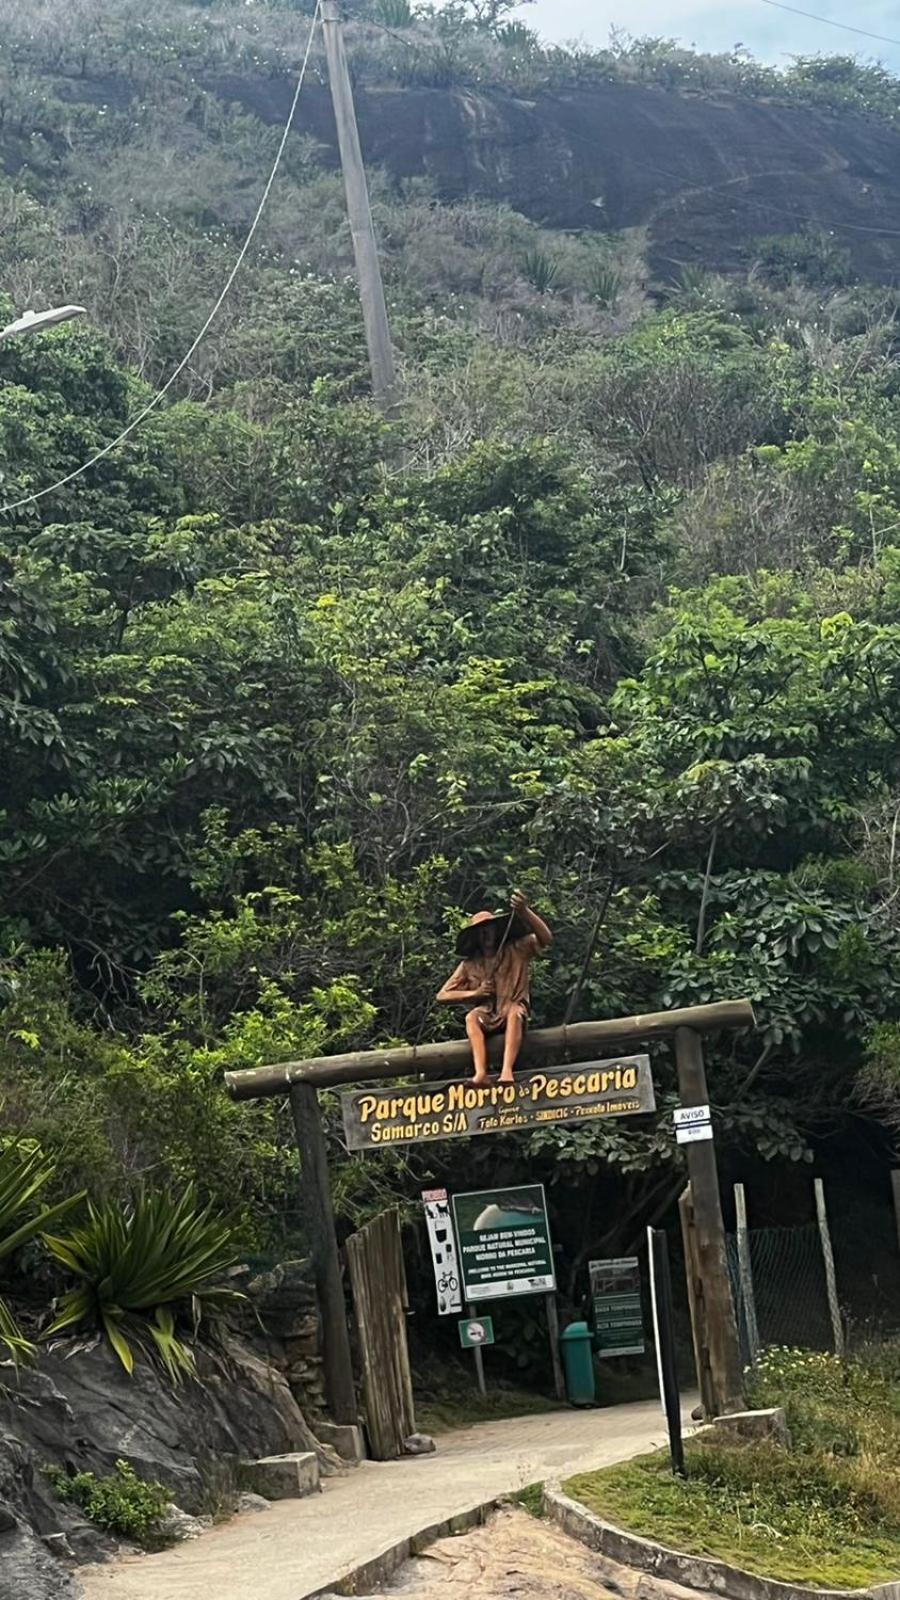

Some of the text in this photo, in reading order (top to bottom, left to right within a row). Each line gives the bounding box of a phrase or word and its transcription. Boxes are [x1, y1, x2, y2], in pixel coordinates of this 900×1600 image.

[358, 1094, 445, 1123] Parque
[448, 1084, 516, 1111] Morro
[529, 1065, 637, 1101] Pescaria
[370, 1112, 468, 1143] Samarco S/A
[680, 1109, 705, 1120] AVISO
